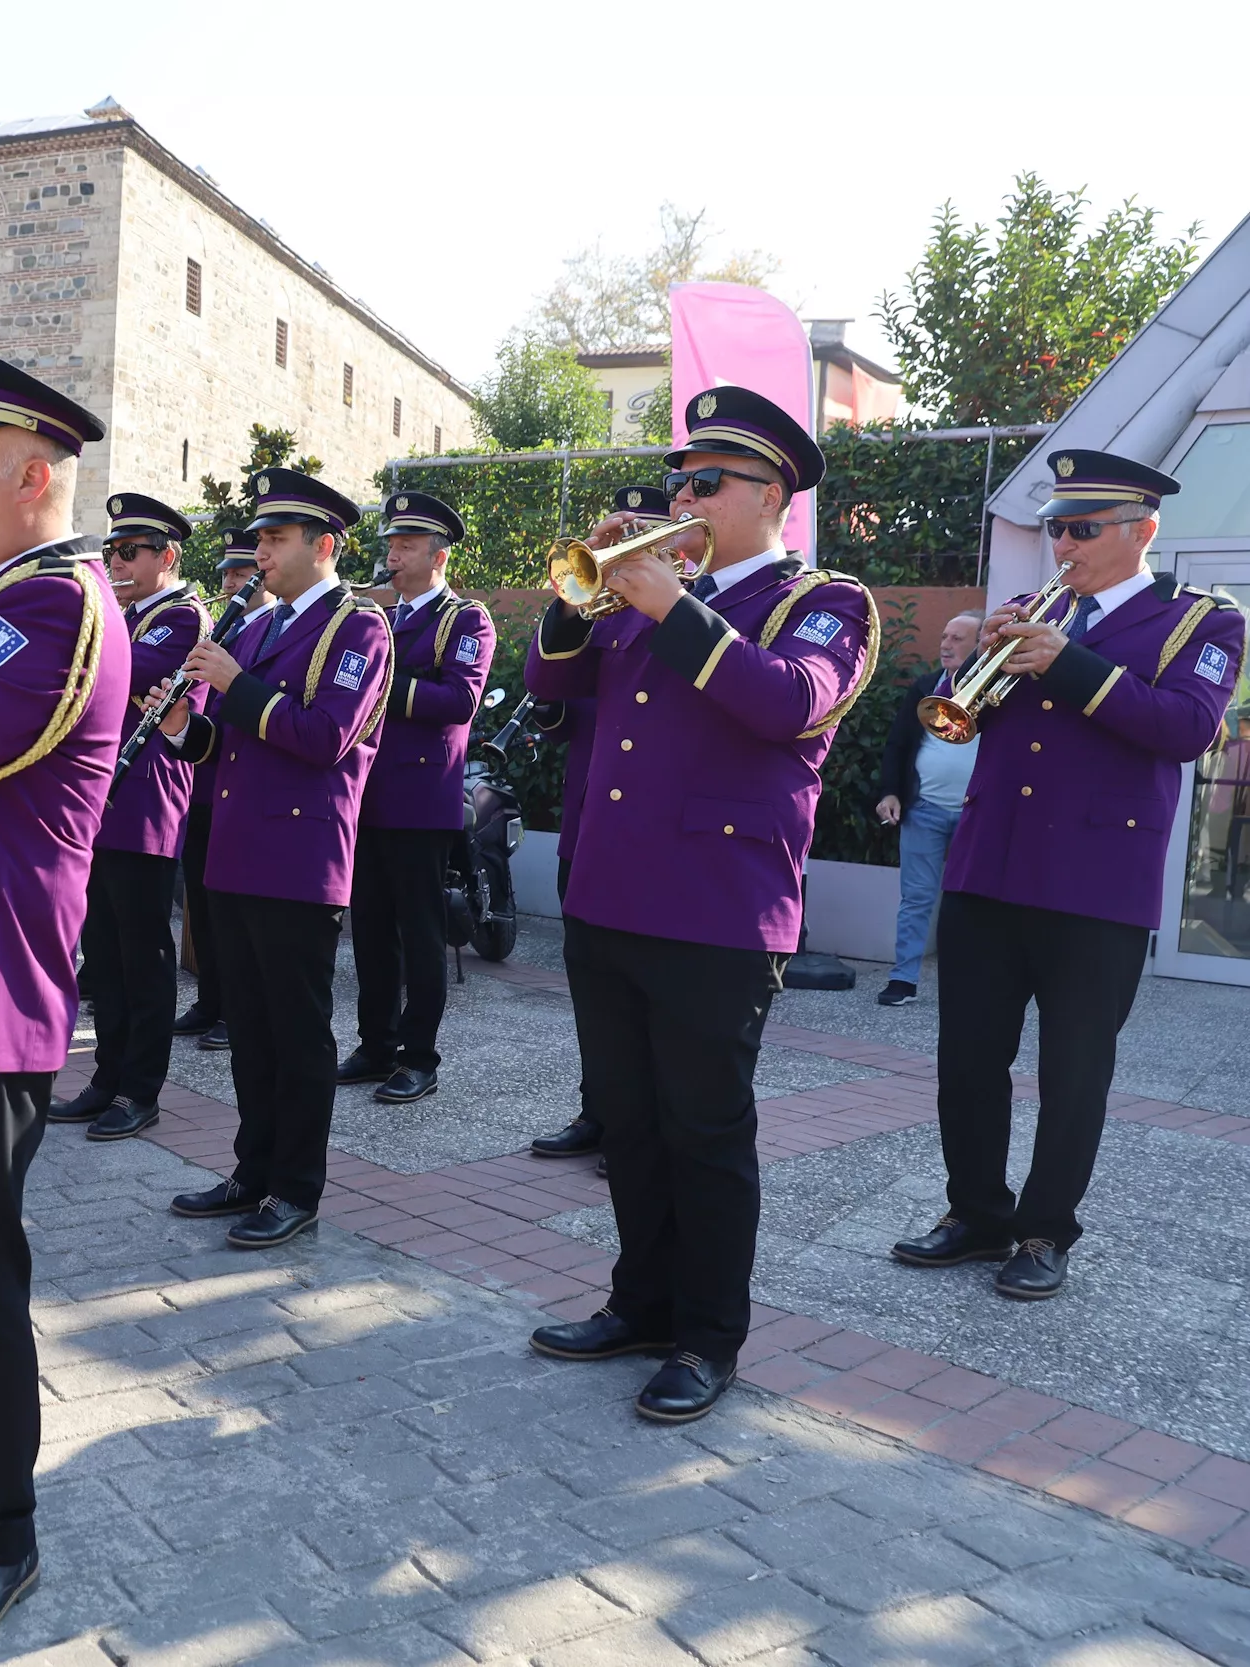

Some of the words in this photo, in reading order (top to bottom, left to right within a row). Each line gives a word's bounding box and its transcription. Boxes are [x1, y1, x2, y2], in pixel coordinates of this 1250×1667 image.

[801, 625, 827, 641] BURSA
[339, 670, 359, 682] BURSA
[1199, 661, 1221, 676] BURSA
